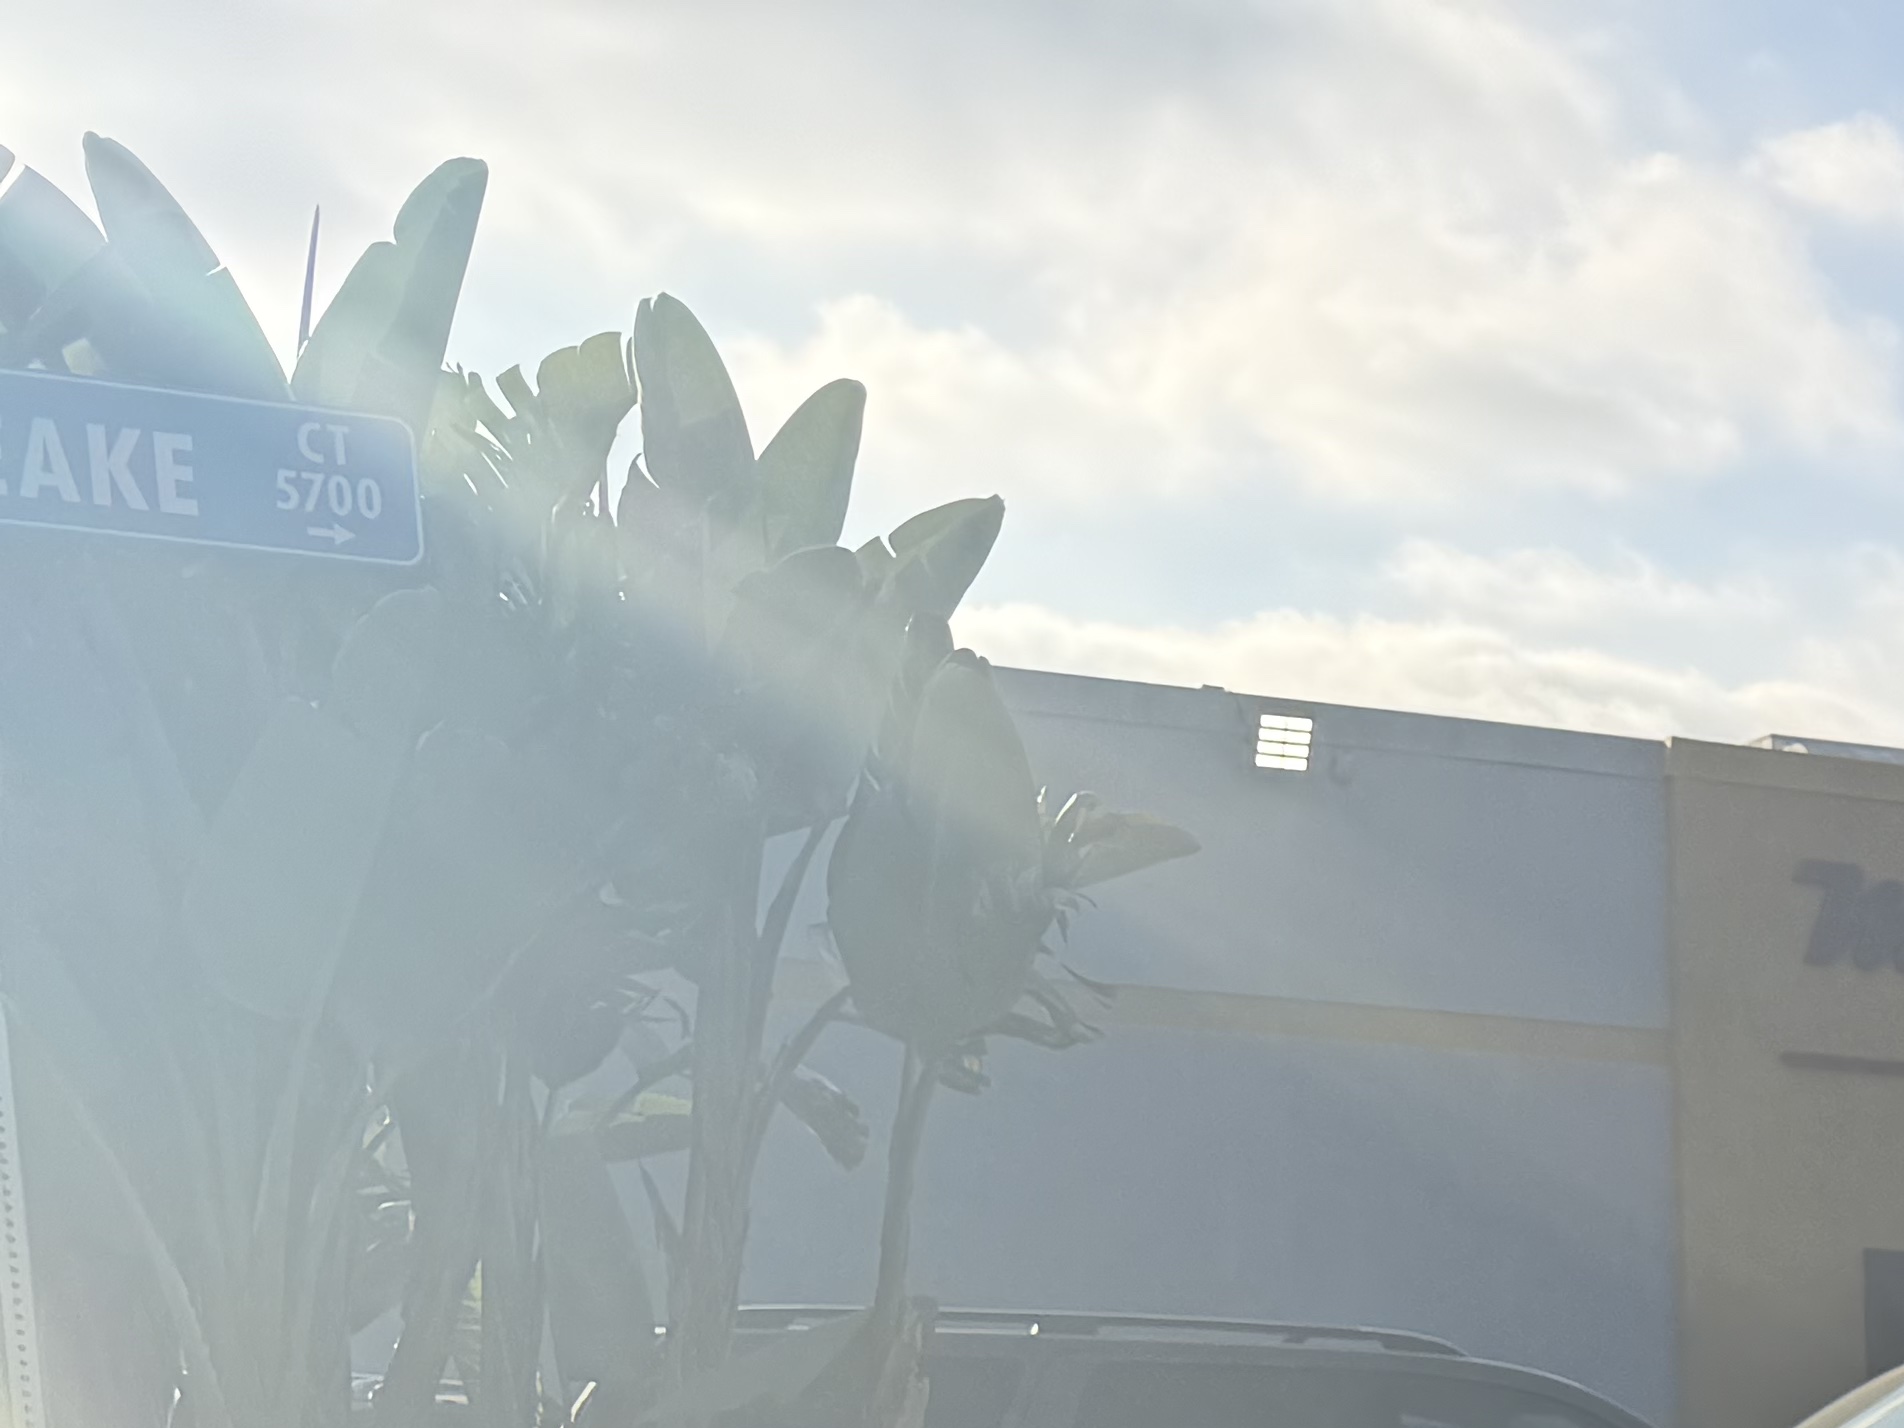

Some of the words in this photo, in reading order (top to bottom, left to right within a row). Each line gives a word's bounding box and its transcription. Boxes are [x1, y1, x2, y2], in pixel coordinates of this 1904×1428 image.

[0, 416, 199, 516] AKE
[297, 422, 350, 466] CT
[275, 469, 382, 519] 5700
